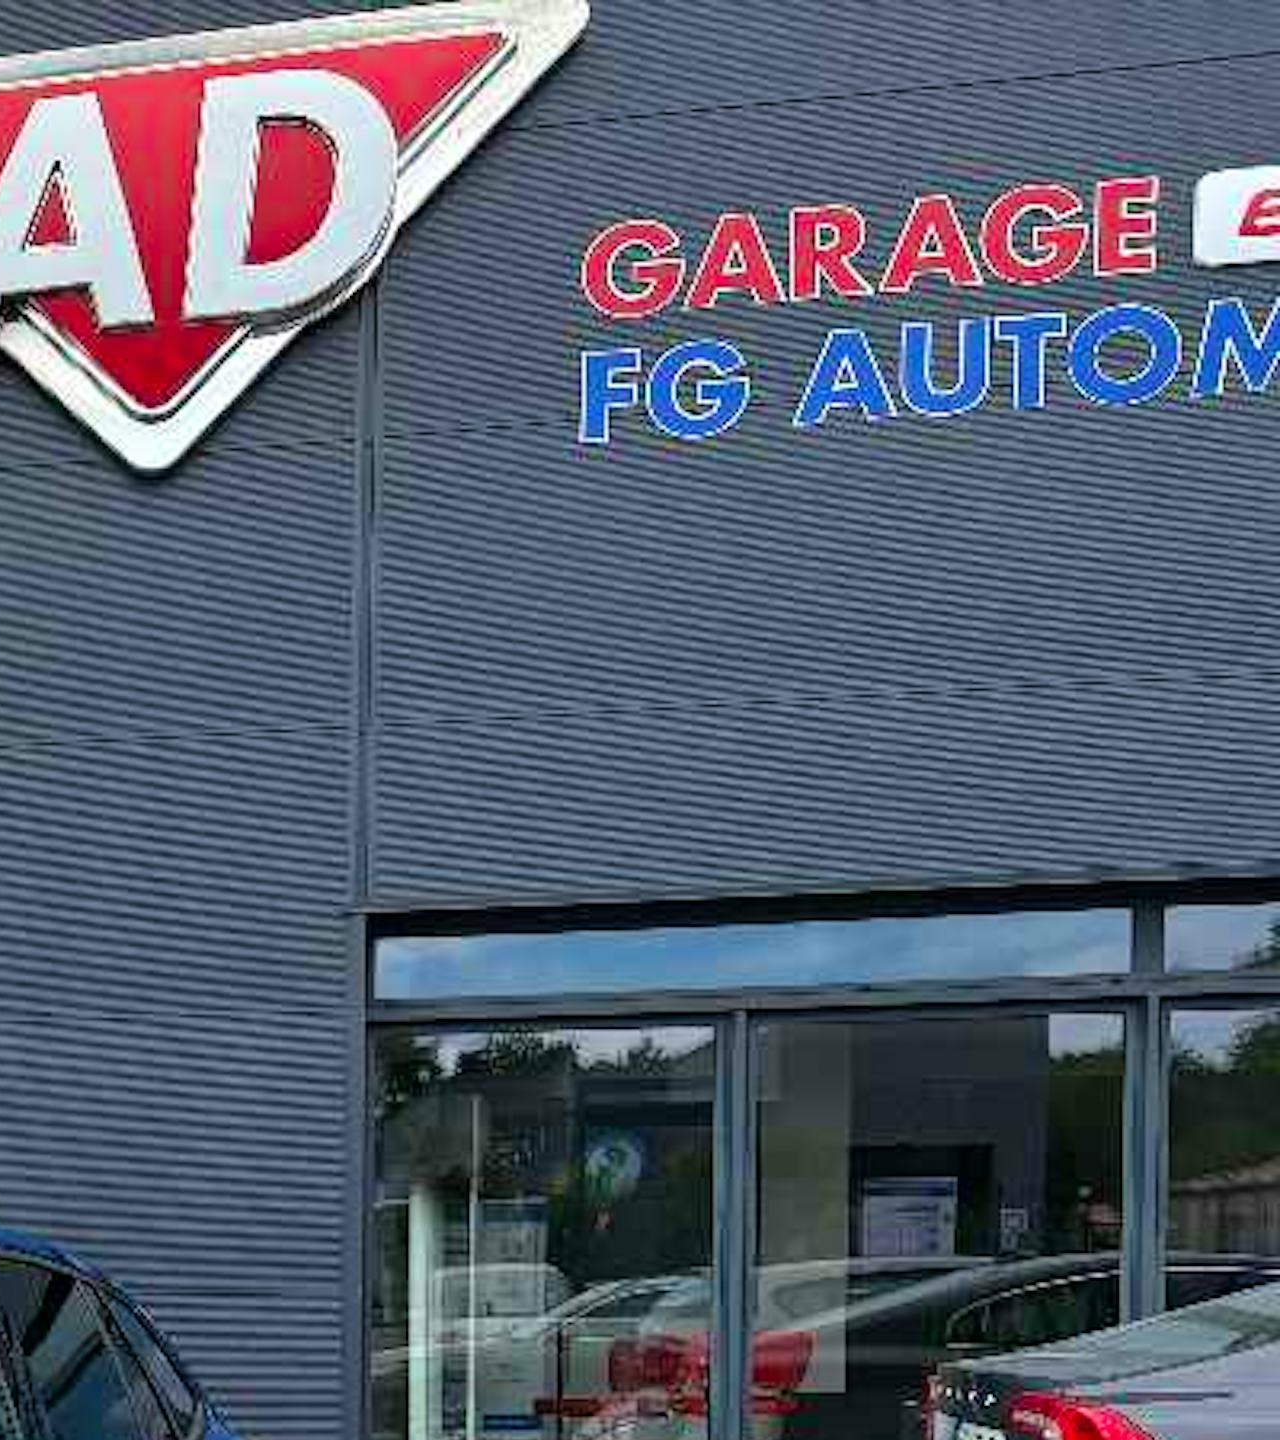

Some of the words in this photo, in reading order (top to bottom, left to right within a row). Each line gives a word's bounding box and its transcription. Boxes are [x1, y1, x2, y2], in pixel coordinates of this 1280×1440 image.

[581, 176, 1160, 320] GARAGE
[577, 339, 751, 444] FG
[792, 297, 1280, 428] AUTOM
